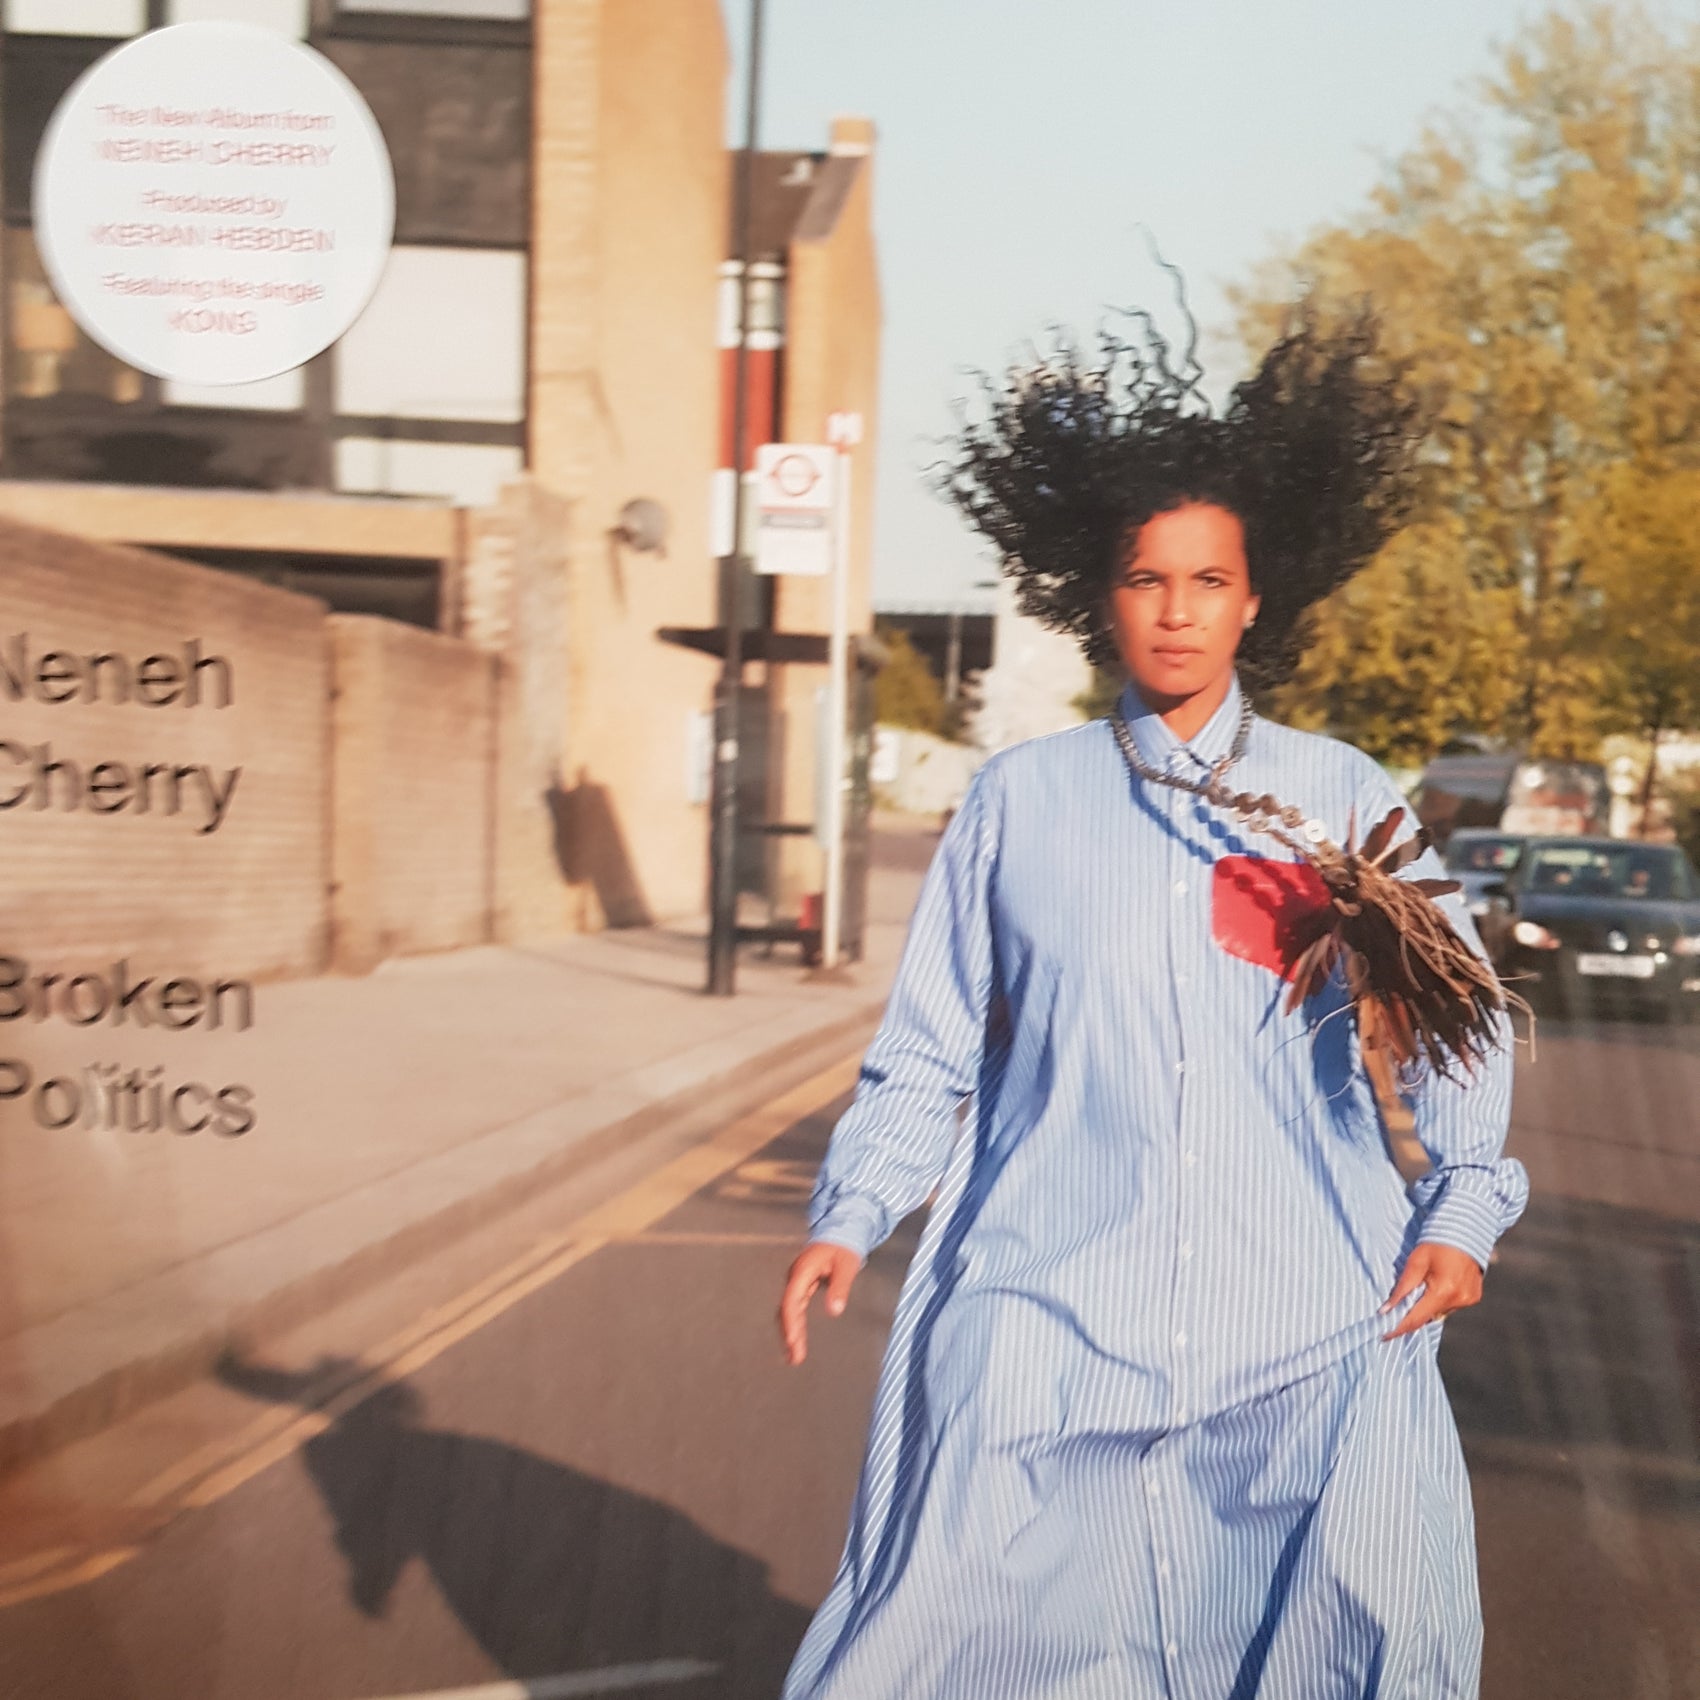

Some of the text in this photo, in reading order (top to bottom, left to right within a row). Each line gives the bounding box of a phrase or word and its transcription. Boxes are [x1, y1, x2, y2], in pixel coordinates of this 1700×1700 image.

[95, 138, 337, 167] NENEH CHERRY
[209, 225, 336, 252] HEBDEN
[167, 308, 258, 335] KONG
[0, 1059, 257, 1140] Politics
